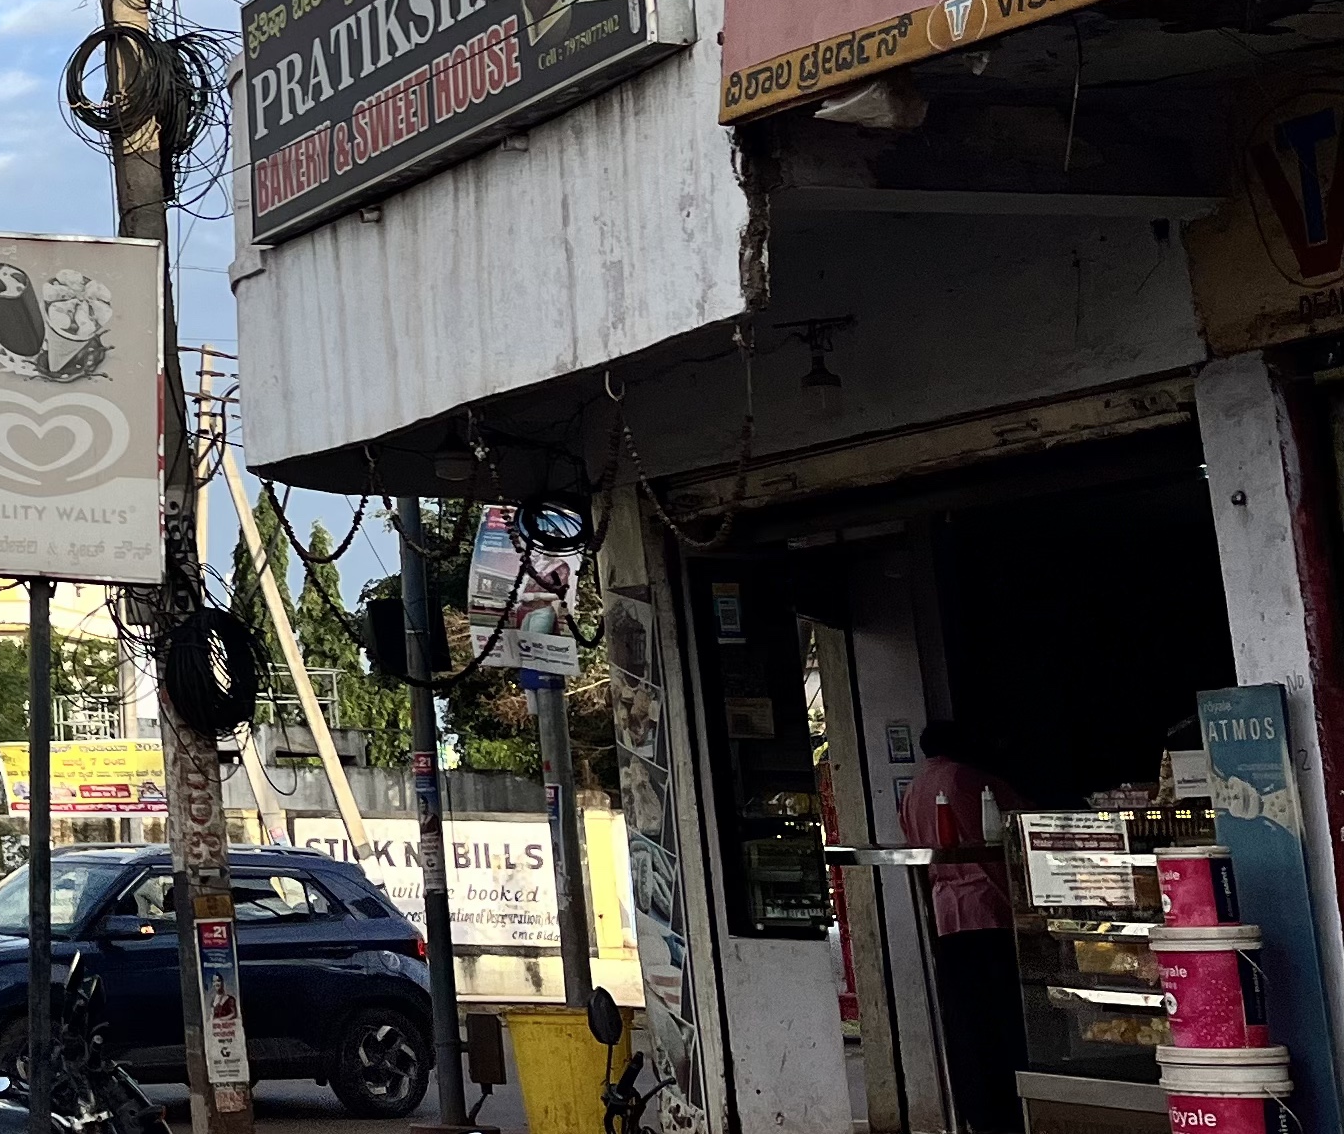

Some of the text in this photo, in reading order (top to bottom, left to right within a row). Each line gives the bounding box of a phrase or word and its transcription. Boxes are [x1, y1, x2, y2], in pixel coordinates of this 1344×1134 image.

[255, 14, 522, 217] BAKERY & SWEET HOUSE
[56, 506, 128, 525] WALL'S
[1208, 717, 1276, 742] ATMOS
[135, 743, 162, 752] 202
[468, 885, 540, 903] booked
[213, 926, 226, 938] 21
